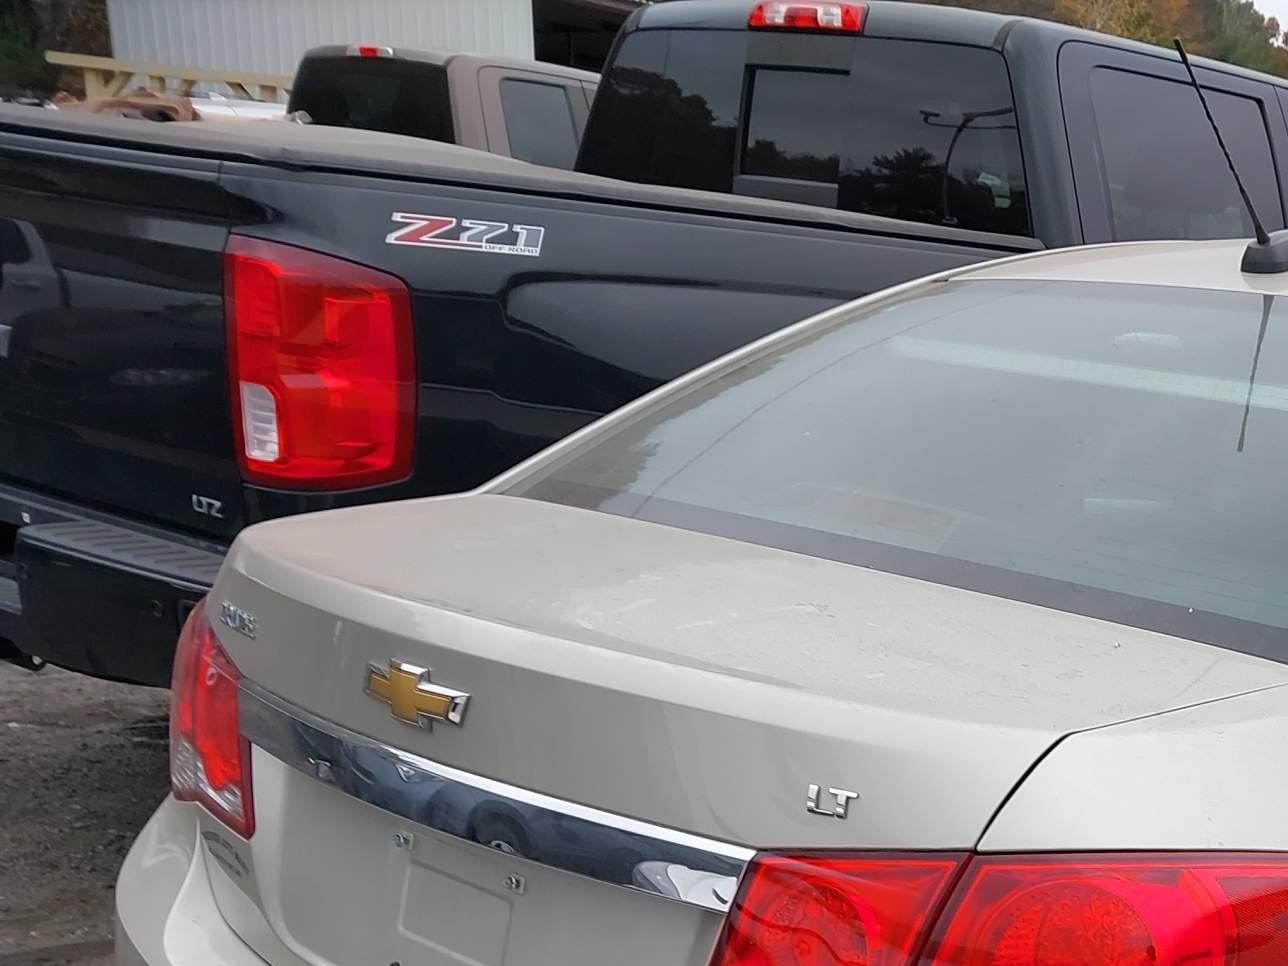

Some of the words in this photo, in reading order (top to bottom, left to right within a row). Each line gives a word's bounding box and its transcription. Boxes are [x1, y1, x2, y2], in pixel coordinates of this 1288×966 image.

[385, 212, 545, 252] Z71
[191, 494, 224, 518] LTZ
[806, 784, 859, 819] LT
